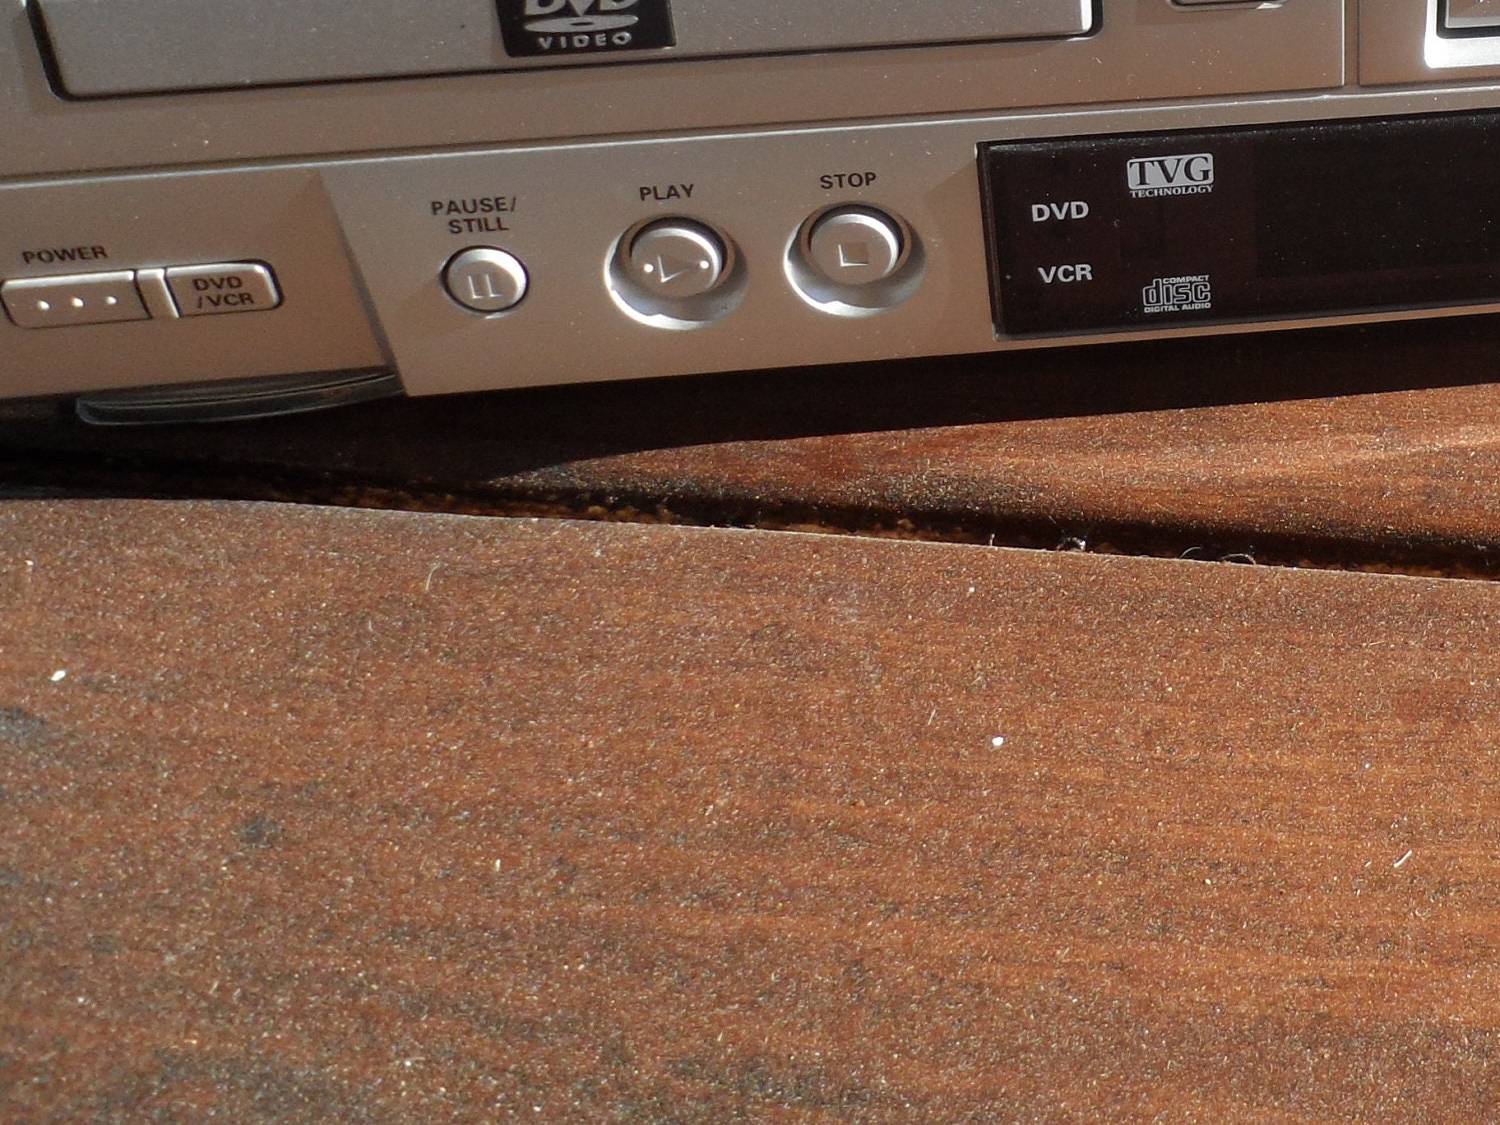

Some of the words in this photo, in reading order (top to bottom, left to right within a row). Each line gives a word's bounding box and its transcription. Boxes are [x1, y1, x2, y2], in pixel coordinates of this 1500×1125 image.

[537, 31, 632, 50] VIDEO
[1130, 156, 1211, 185] TVG
[820, 171, 878, 191] STOP
[639, 183, 696, 203] PLAY
[1130, 185, 1214, 198] TECHNOLOGY
[430, 196, 518, 217] PAUSE/
[1031, 200, 1090, 223] DVD
[448, 216, 510, 234] STILL
[22, 246, 109, 266] POWER
[1037, 263, 1094, 284] VCR
[1162, 274, 1210, 285] COMPACT
[193, 276, 243, 293] DVD
[1142, 278, 1212, 306] disc
[197, 290, 255, 309] /VCR
[1144, 304, 1180, 314] DIGITAL
[1181, 302, 1212, 311] AUDIO
